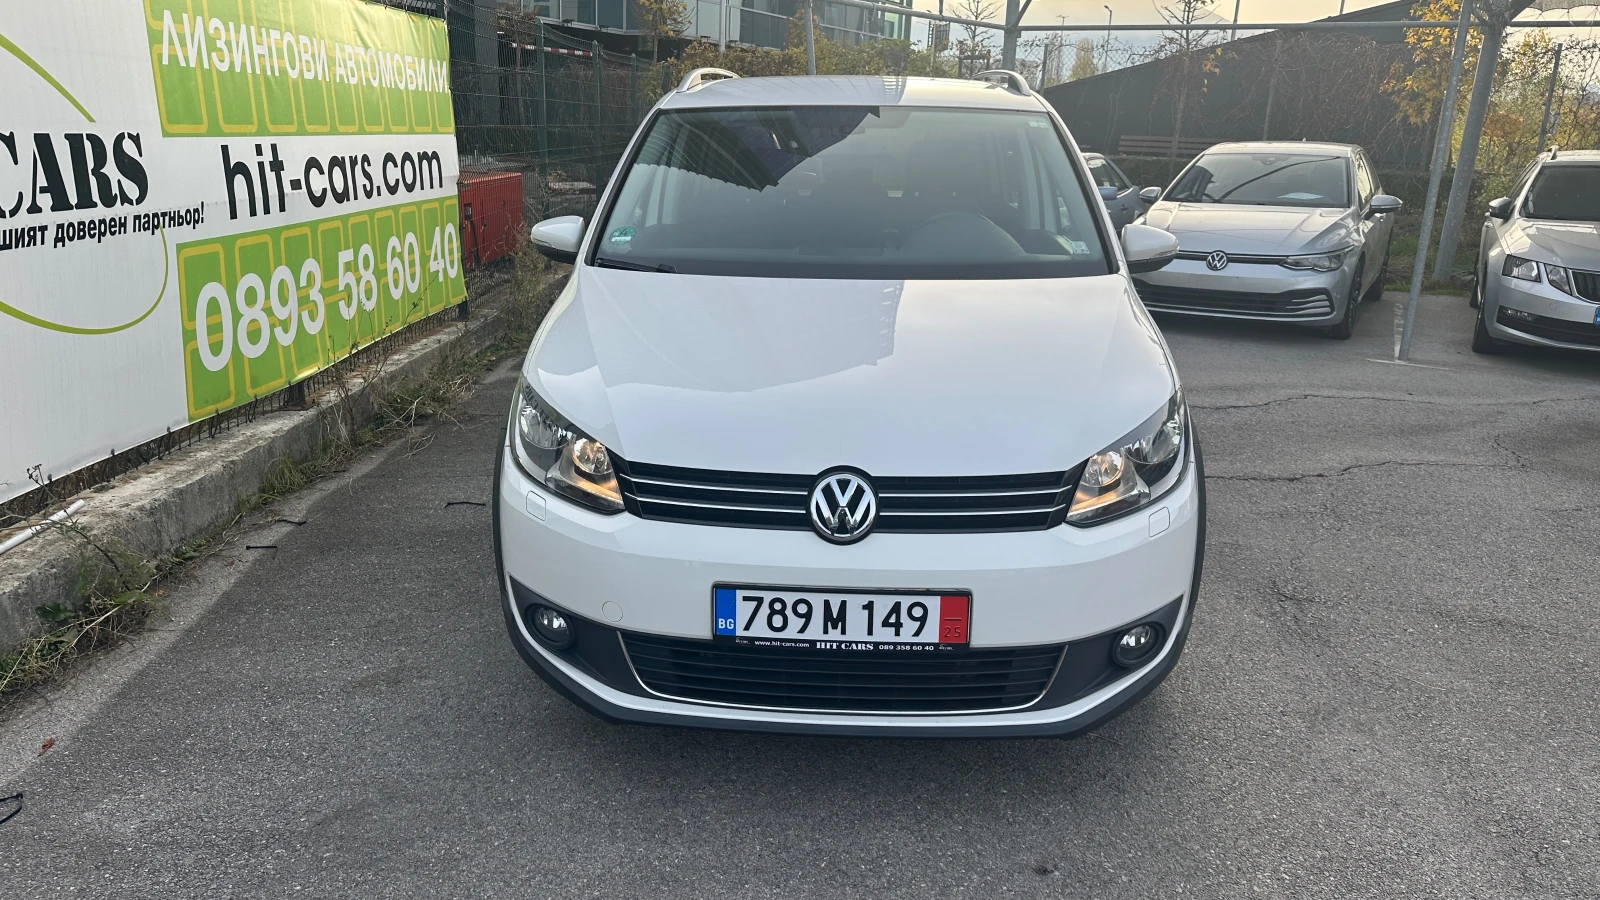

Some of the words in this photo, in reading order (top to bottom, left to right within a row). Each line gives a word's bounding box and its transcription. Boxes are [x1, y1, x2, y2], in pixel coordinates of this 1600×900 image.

[161, 10, 330, 82] ЛИЗИНГОВИ
[335, 45, 448, 94] АВТОМОБИЛИ
[220, 143, 444, 220] hit-cars.com
[53, 215, 128, 249] доверен
[132, 201, 205, 236] партньор!
[195, 257, 325, 372] 0893
[338, 243, 378, 320] 58
[386, 232, 421, 300] 60
[429, 222, 459, 283] 40
[812, 474, 875, 537] VW
[718, 618, 735, 630] BG
[741, 595, 813, 634] 789
[822, 598, 847, 635] M
[861, 600, 929, 638] 149
[944, 625, 962, 638] 25
[754, 639, 810, 648] www.hit-cars.com
[816, 641, 840, 650] HIT
[841, 642, 874, 651] CARS
